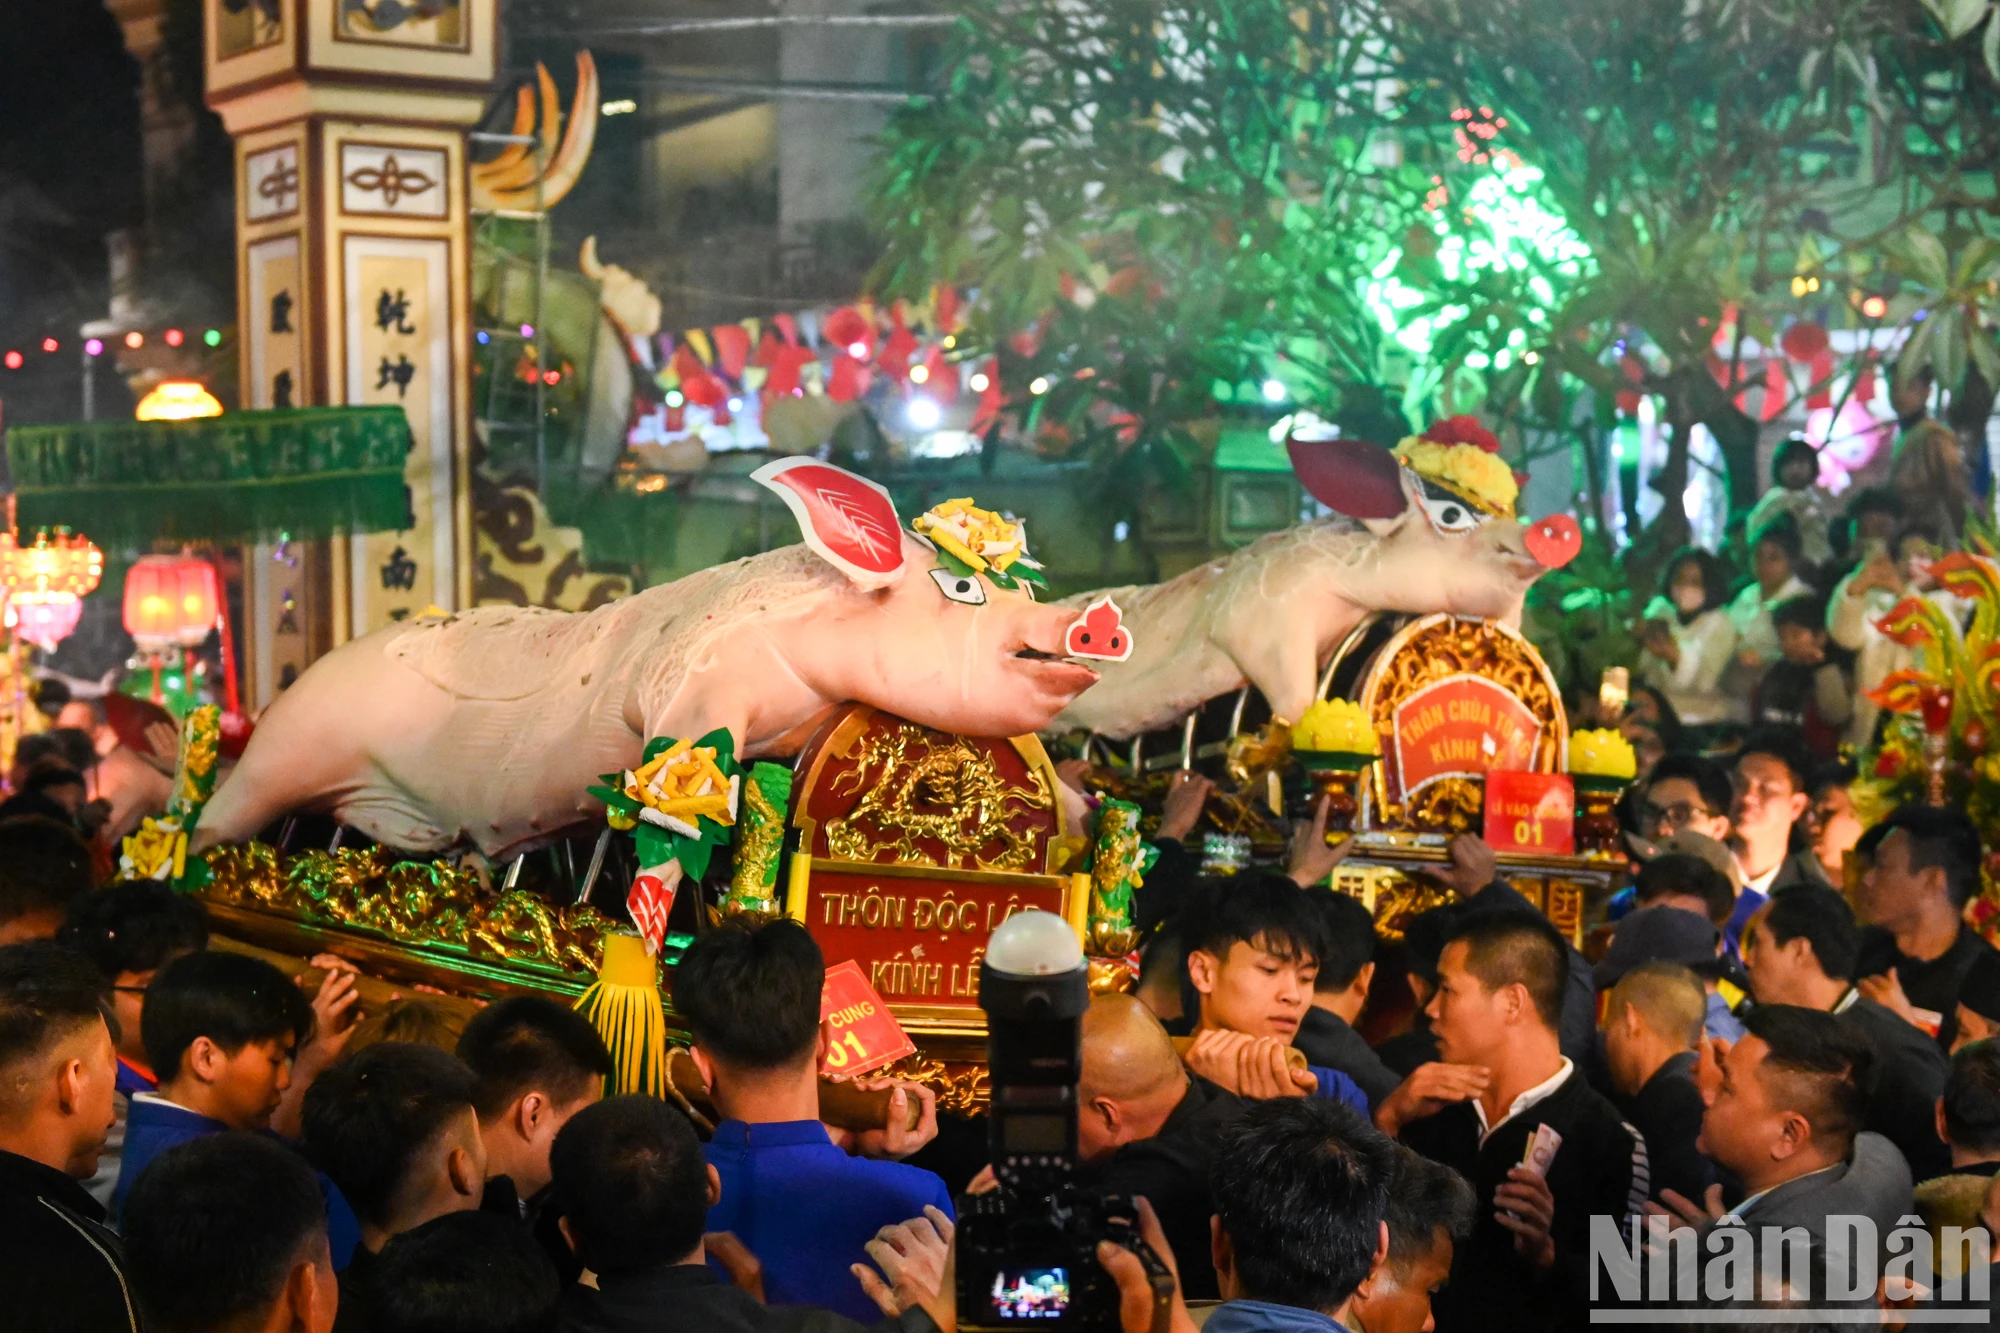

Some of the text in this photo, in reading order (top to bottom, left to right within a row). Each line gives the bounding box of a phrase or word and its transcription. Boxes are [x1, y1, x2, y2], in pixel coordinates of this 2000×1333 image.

[1514, 820, 1543, 845] 01
[820, 886, 906, 927] THÔN
[913, 891, 979, 942] ĐỘC
[871, 952, 943, 996] KÍNH
[828, 1001, 876, 1029] CUNG
